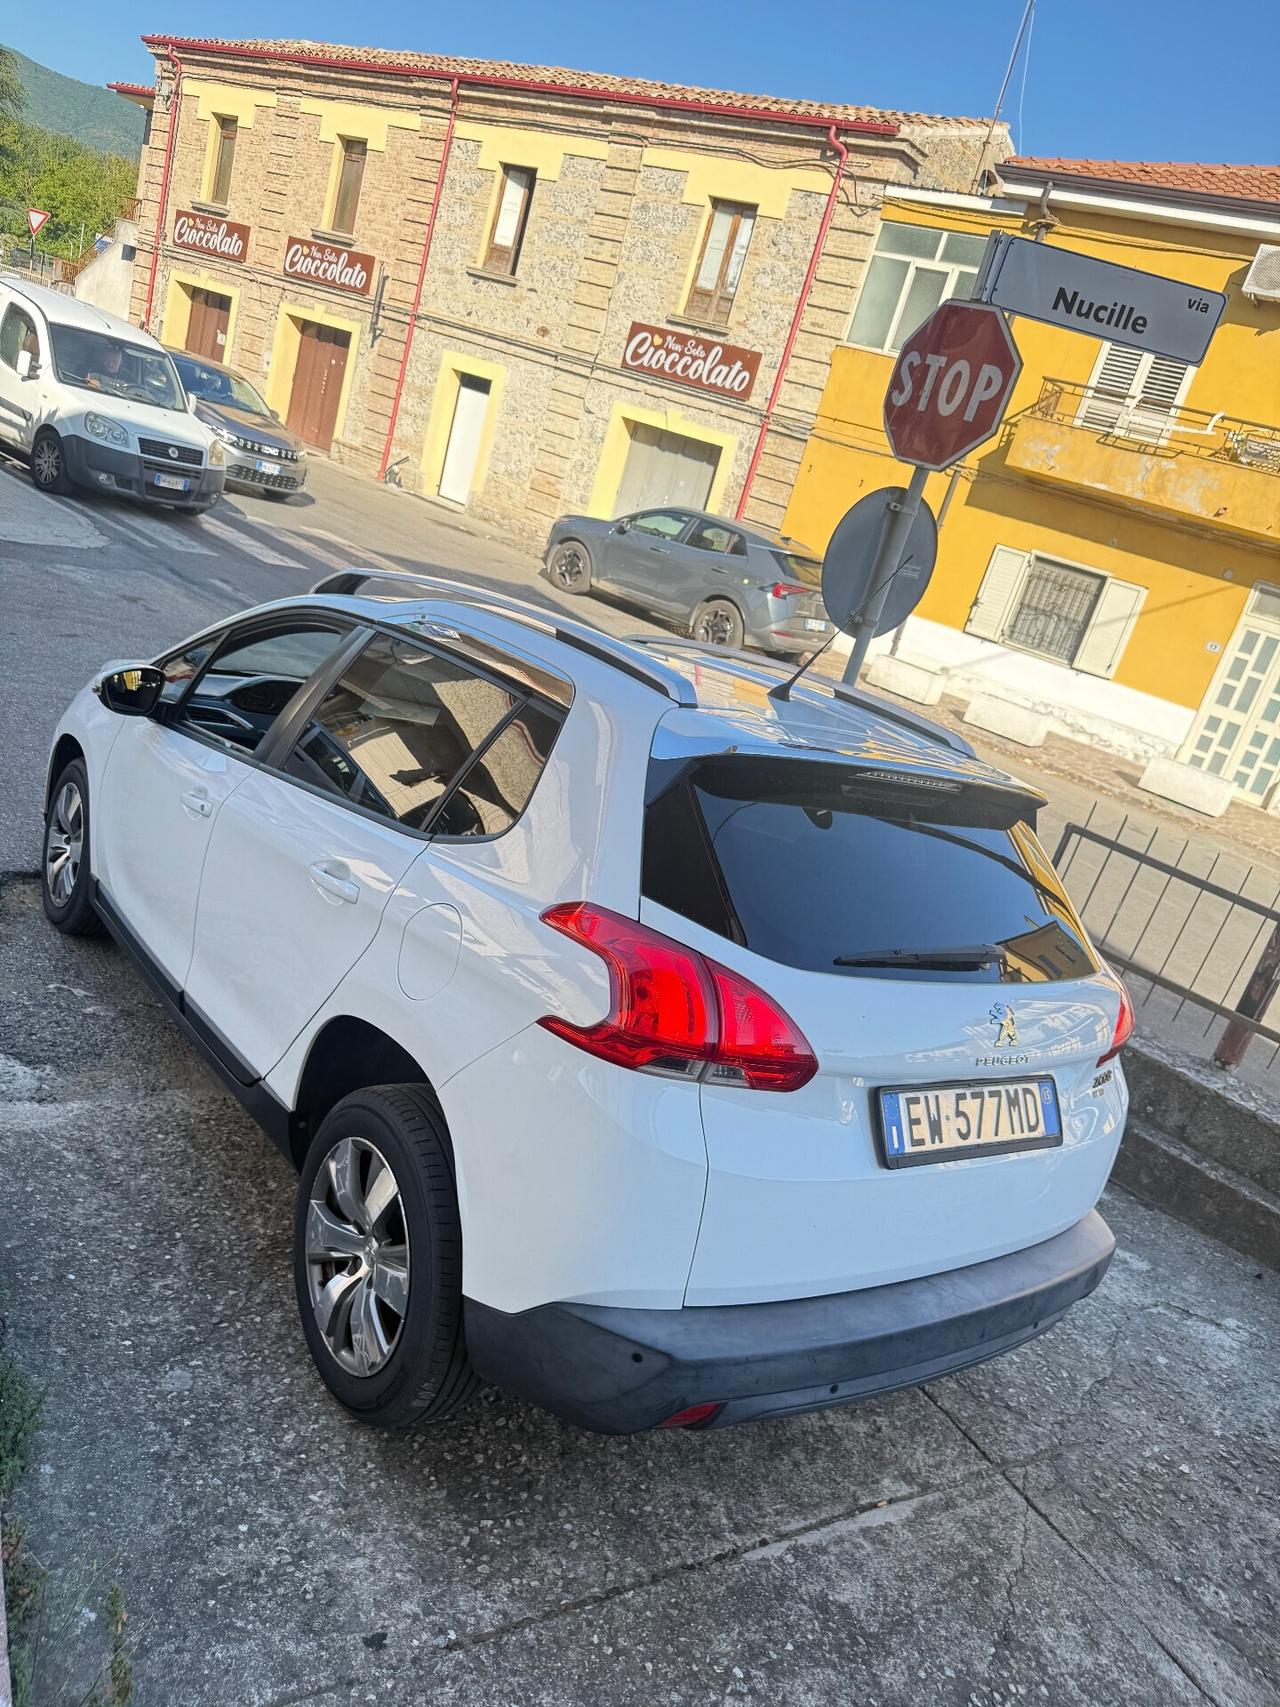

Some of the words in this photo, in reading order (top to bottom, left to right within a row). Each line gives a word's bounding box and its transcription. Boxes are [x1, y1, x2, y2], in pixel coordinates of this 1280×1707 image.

[174, 216, 243, 256] Cioccolato
[285, 244, 366, 288] Cioccolato
[1052, 287, 1148, 334] Nucille
[1187, 298, 1209, 314] via
[625, 332, 750, 392] Cioccolato
[664, 335, 683, 352] Non
[684, 340, 706, 358] Solo
[891, 351, 1003, 422] STOP
[975, 1055, 1029, 1066] PEUGEOT
